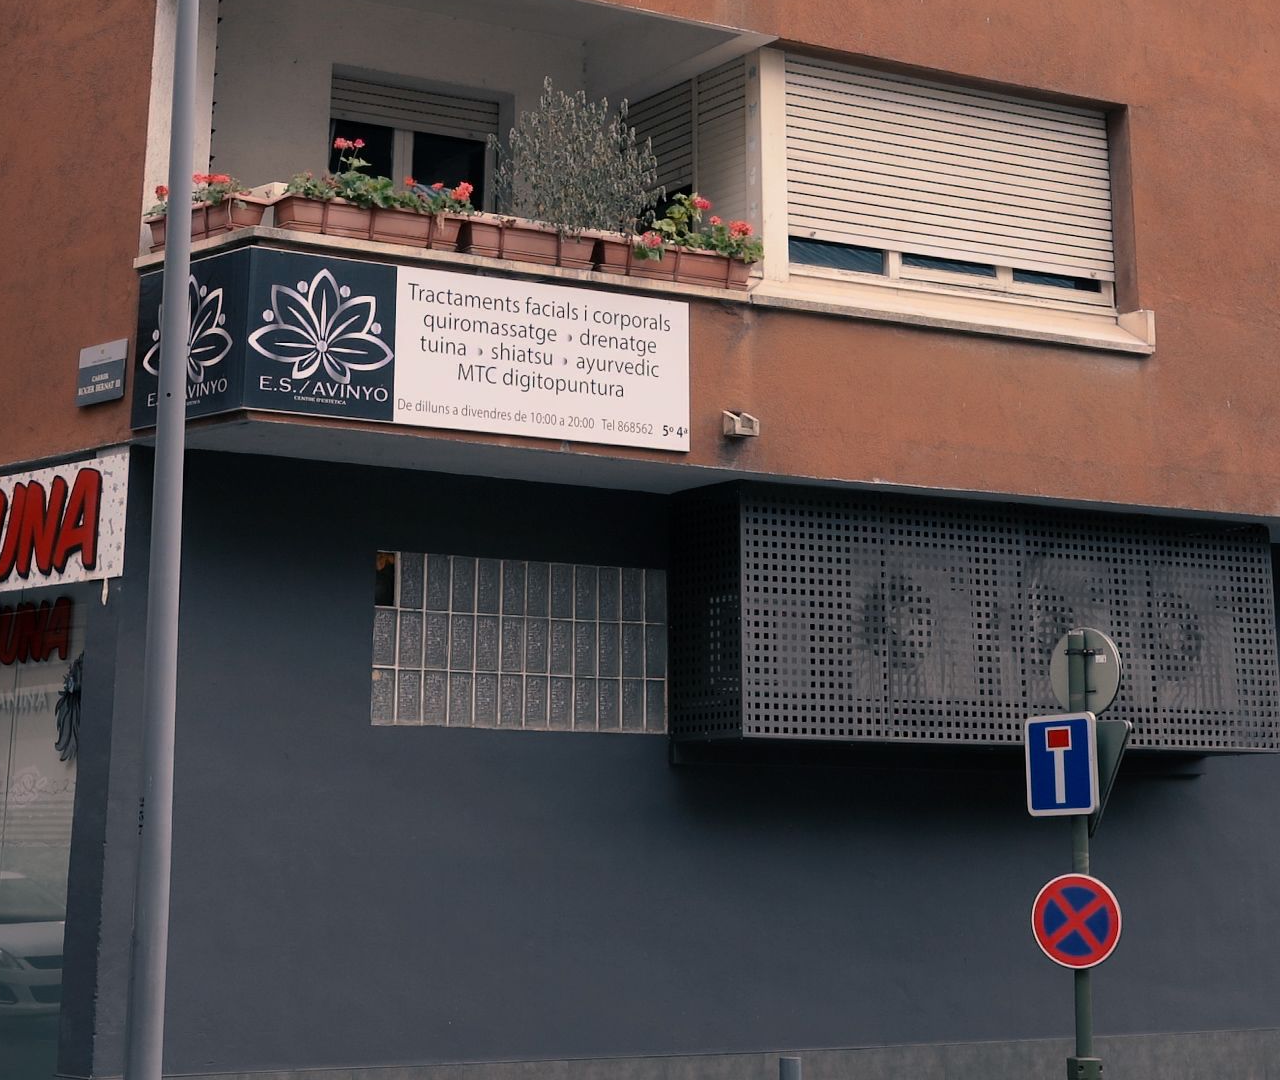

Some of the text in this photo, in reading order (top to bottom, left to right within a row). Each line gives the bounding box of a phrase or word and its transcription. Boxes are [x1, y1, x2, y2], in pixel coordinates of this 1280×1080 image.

[408, 283, 671, 333] Tractaments facials i corporals
[420, 335, 659, 379] tuina shiatsu ayurvedic
[423, 314, 658, 357] quiromassatge drenatge
[457, 363, 625, 399] MTC digitopuntura
[397, 399, 413, 412] De
[415, 399, 450, 416] dilluns
[453, 406, 459, 416] a
[461, 404, 513, 422] divendres
[514, 409, 528, 423] de
[530, 411, 557, 426] 10:00
[559, 417, 565, 427] a
[568, 416, 595, 429] 20:00
[601, 418, 616, 431] Tel
[617, 421, 654, 436] 868562
